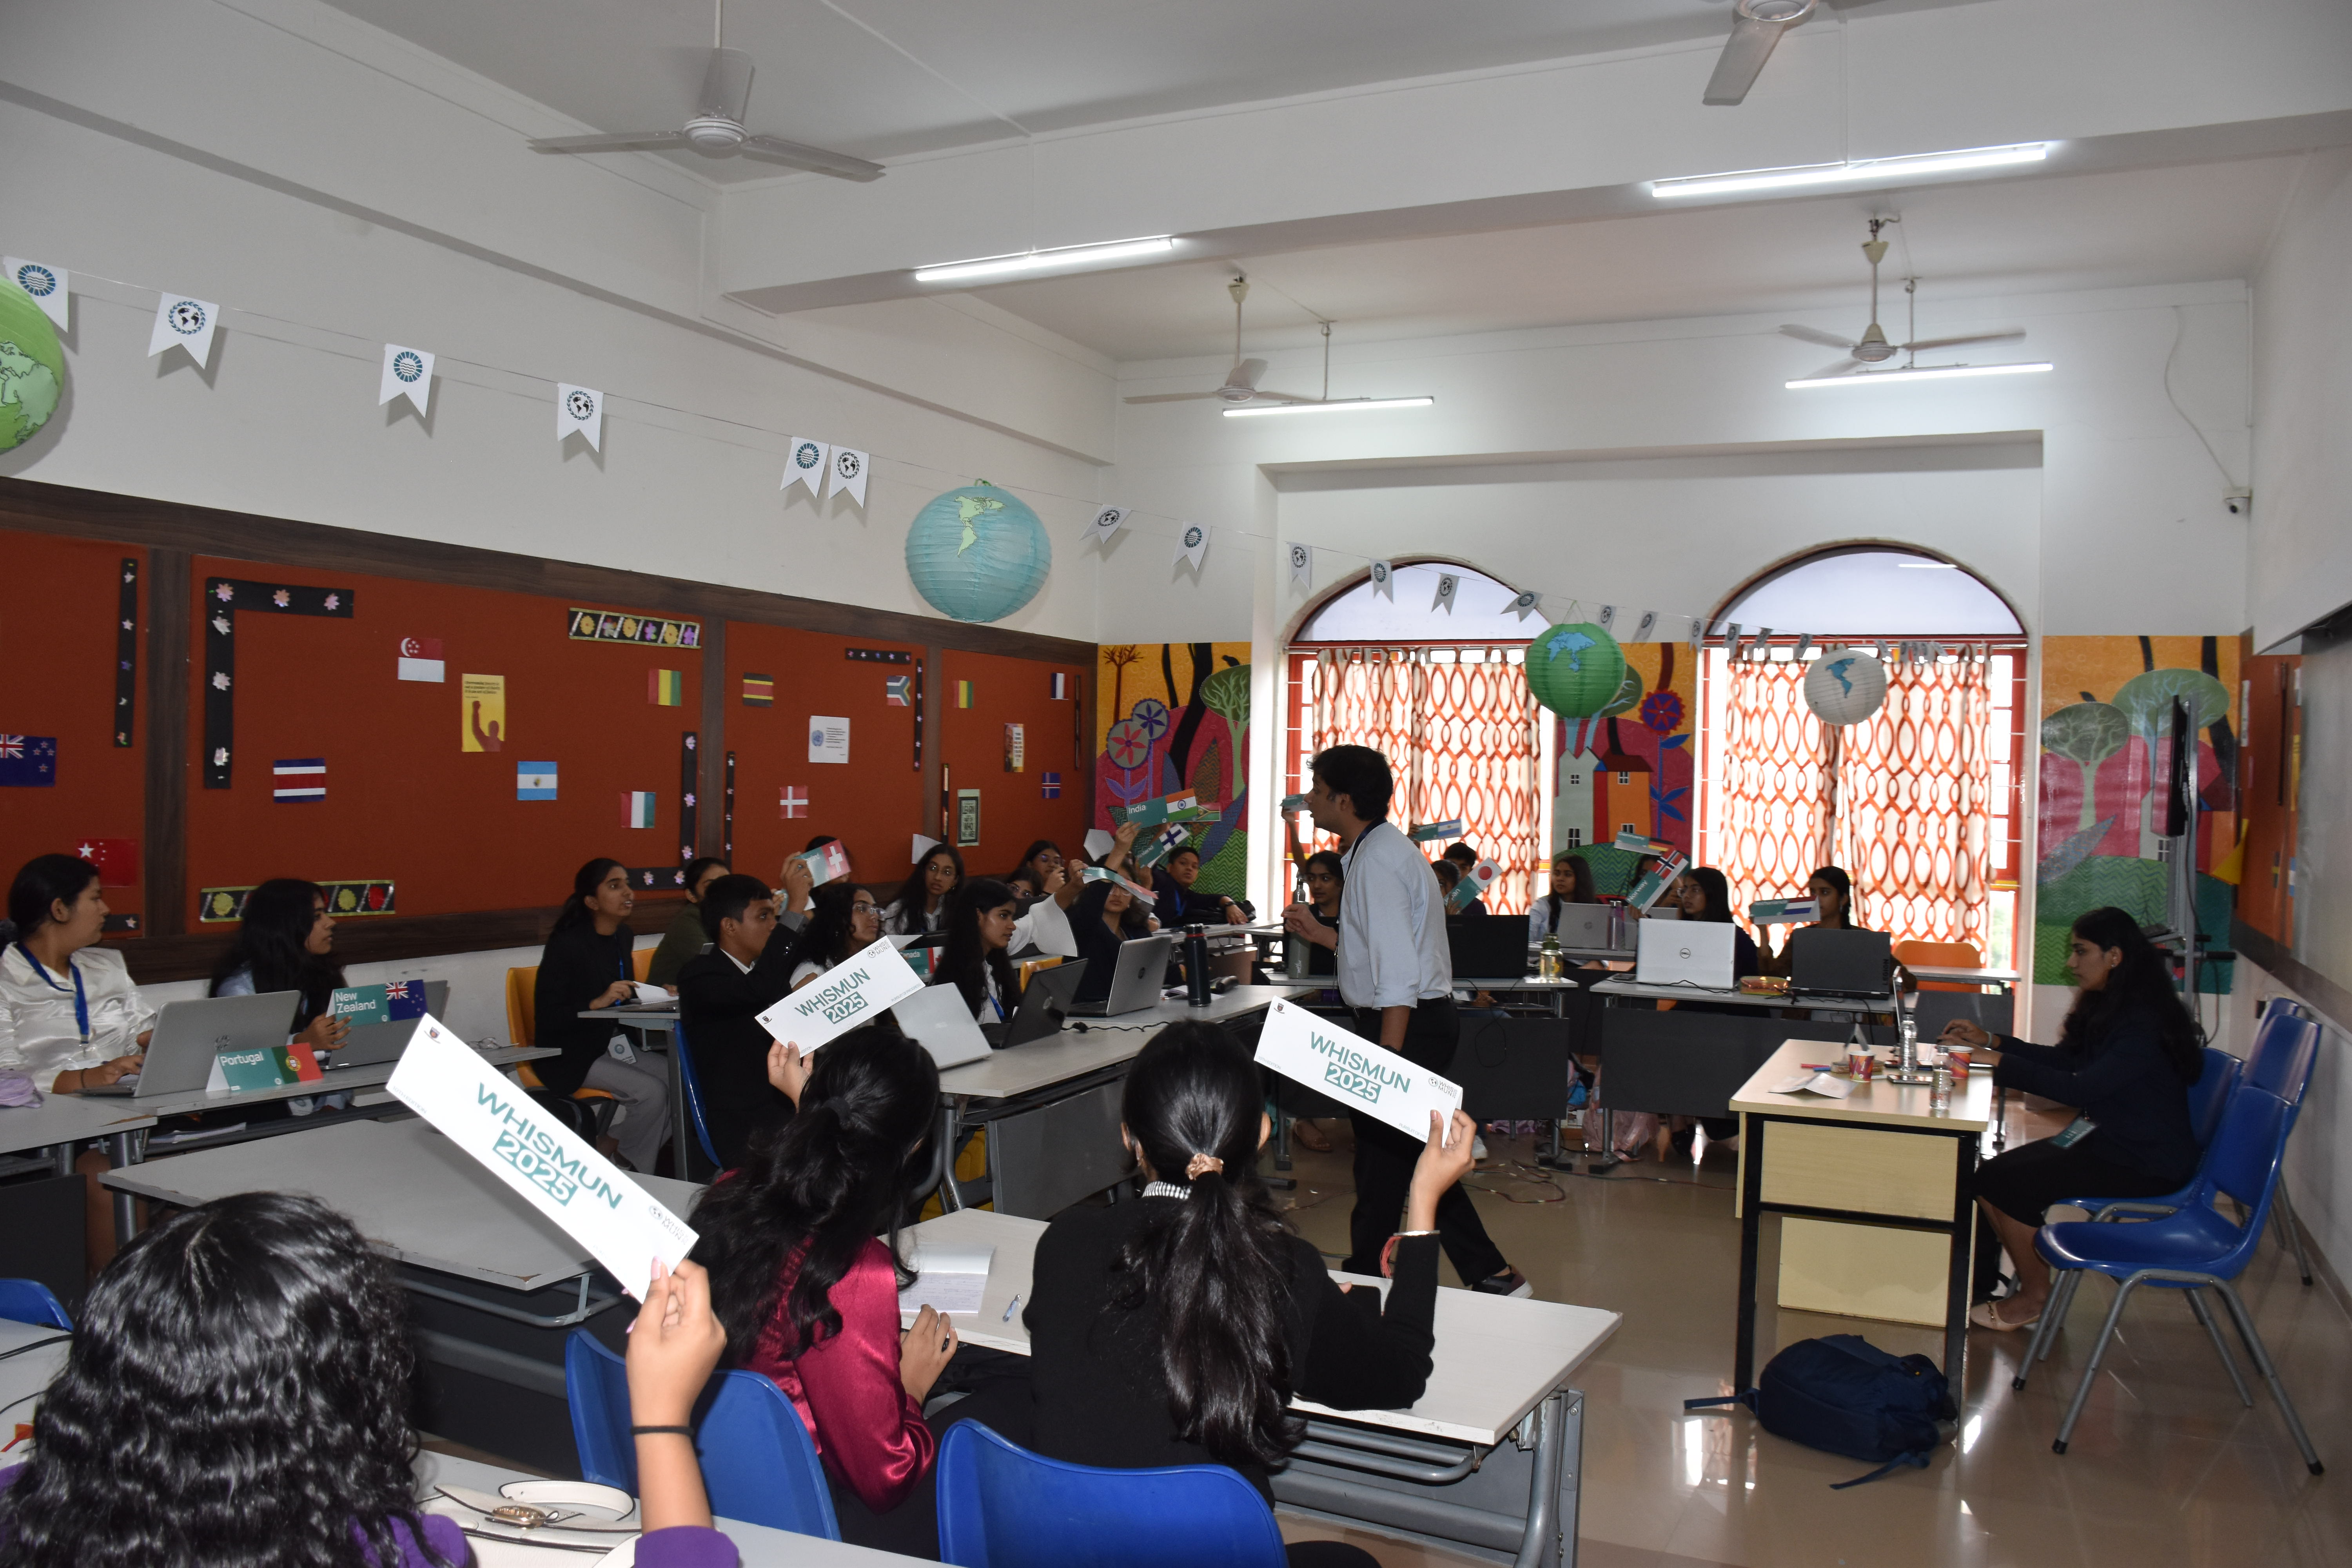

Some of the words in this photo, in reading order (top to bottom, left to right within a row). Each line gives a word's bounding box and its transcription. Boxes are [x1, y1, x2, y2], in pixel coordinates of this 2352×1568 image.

[1129, 804, 1146, 814] India
[1627, 880, 1648, 902] Norway
[335, 992, 357, 1002] New
[794, 967, 871, 1016] WHISMUN
[336, 999, 376, 1013] Zealand
[826, 993, 865, 1023] 2025
[220, 1051, 264, 1066] Portugal
[1311, 1031, 1411, 1093] WHISMUN
[1327, 1065, 1378, 1100] 2025
[1438, 1085, 1452, 1096] MUN
[1439, 1080, 1454, 1092] WHIS
[478, 1082, 623, 1209] WHISMUN
[496, 1134, 574, 1201] 2025
[662, 1220, 681, 1240] MUN
[665, 1215, 684, 1236] WHIS
